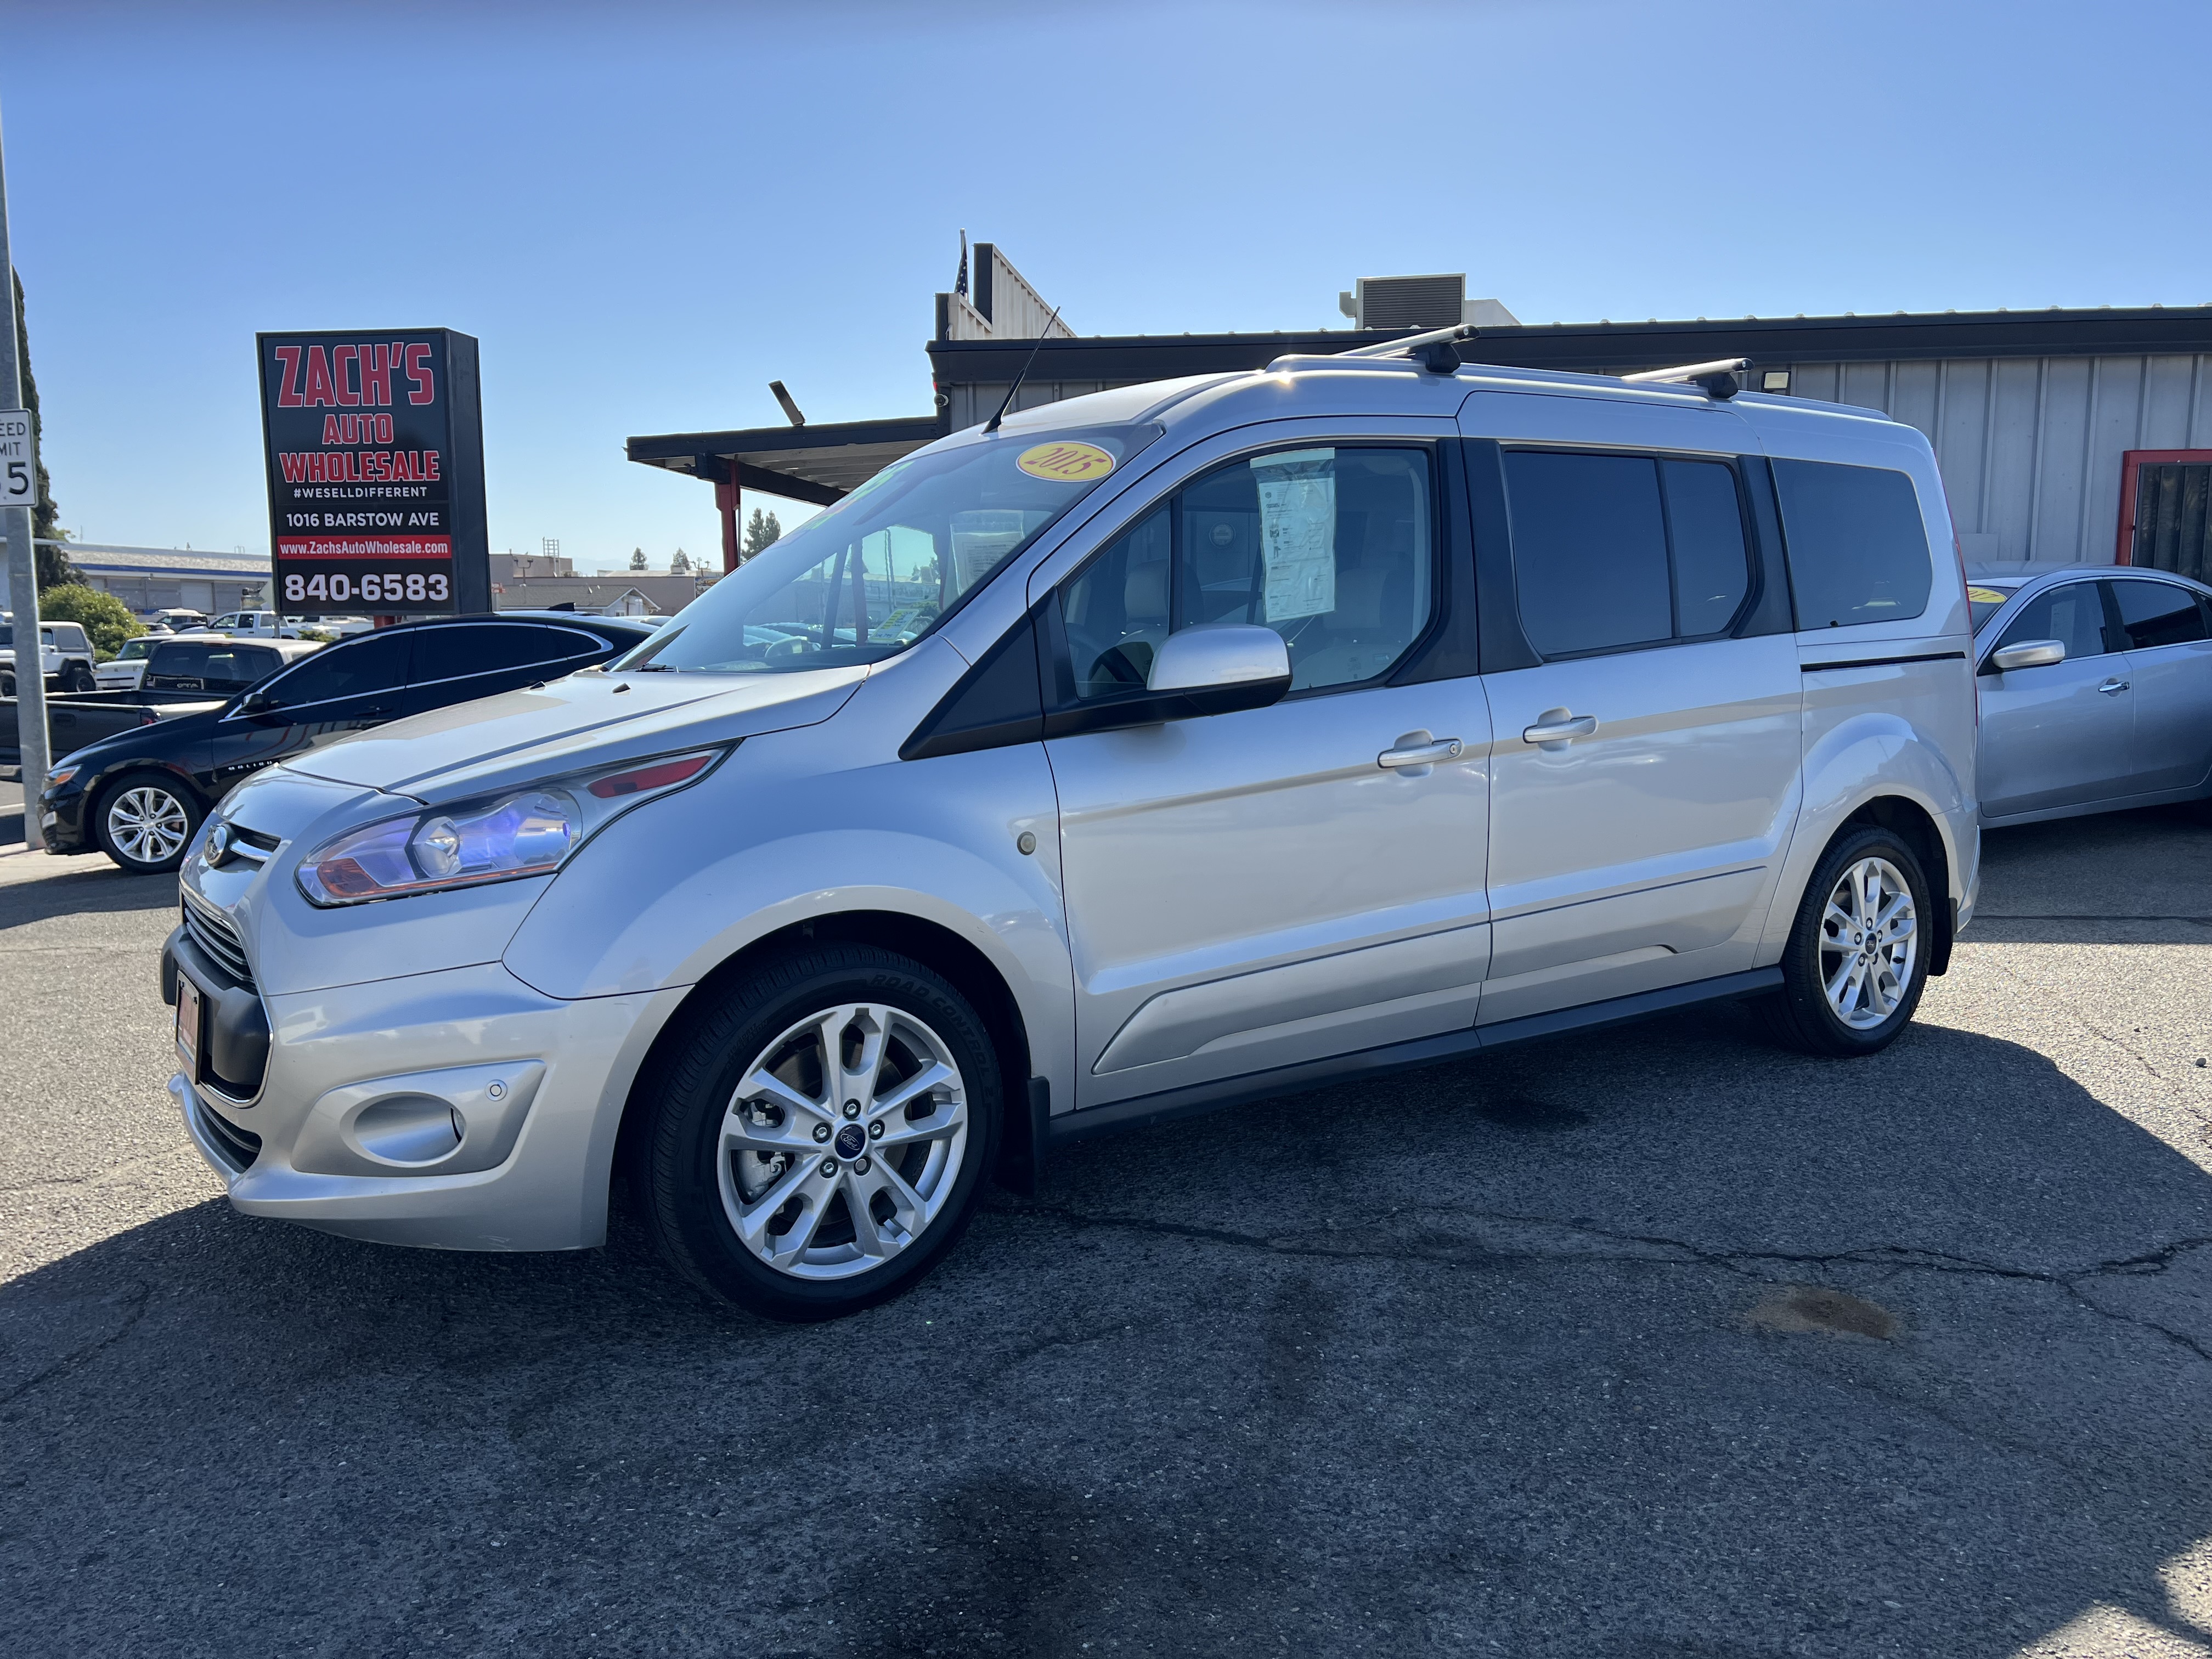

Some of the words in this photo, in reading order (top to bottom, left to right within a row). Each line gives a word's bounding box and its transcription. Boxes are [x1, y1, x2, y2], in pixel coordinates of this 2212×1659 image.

[275, 342, 435, 408] ZACH'S
[322, 413, 394, 445] AUTO
[279, 450, 441, 483] WHOLESALE
[1024, 447, 1107, 475] 2015
[0, 461, 29, 495] 5
[294, 487, 428, 499] #WESELLDIFFERENT
[286, 513, 320, 527] 1016
[324, 512, 403, 527] BARSTOW
[408, 512, 439, 527] AVE
[280, 540, 448, 555] www.ZachsAutoWholesale.com
[285, 573, 449, 602] 840-6583
[871, 974, 930, 998] ROAD
[931, 996, 991, 1077] CONTROL
[843, 1136, 858, 1148] Ford
